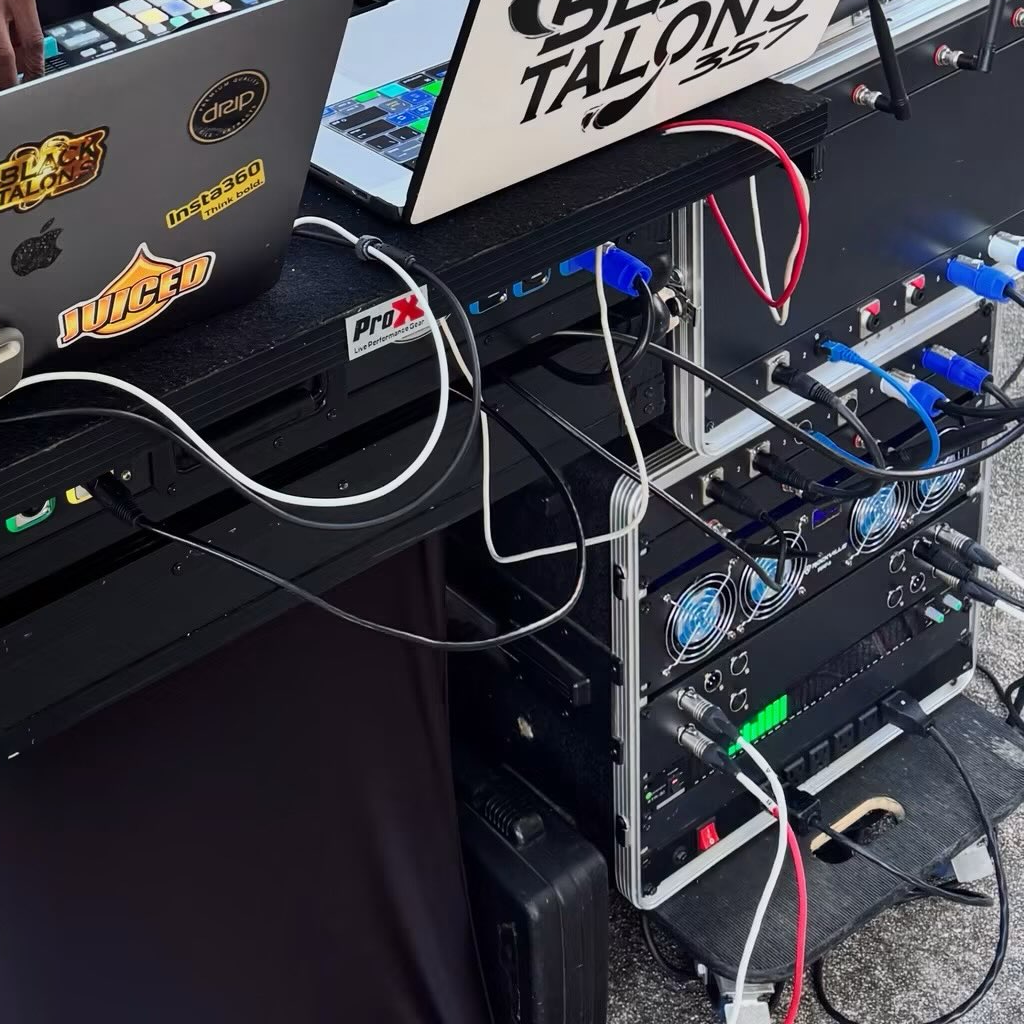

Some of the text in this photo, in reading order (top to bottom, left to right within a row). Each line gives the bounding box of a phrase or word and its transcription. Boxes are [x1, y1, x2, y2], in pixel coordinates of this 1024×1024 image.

[678, 13, 810, 86] 357
[0, 133, 104, 187] BLACK
[168, 161, 261, 226] Insta360
[204, 178, 264, 217] Think bold.
[62, 255, 211, 342] JUICED
[353, 294, 425, 343] ProX
[354, 319, 425, 354] Live Performance Gear
